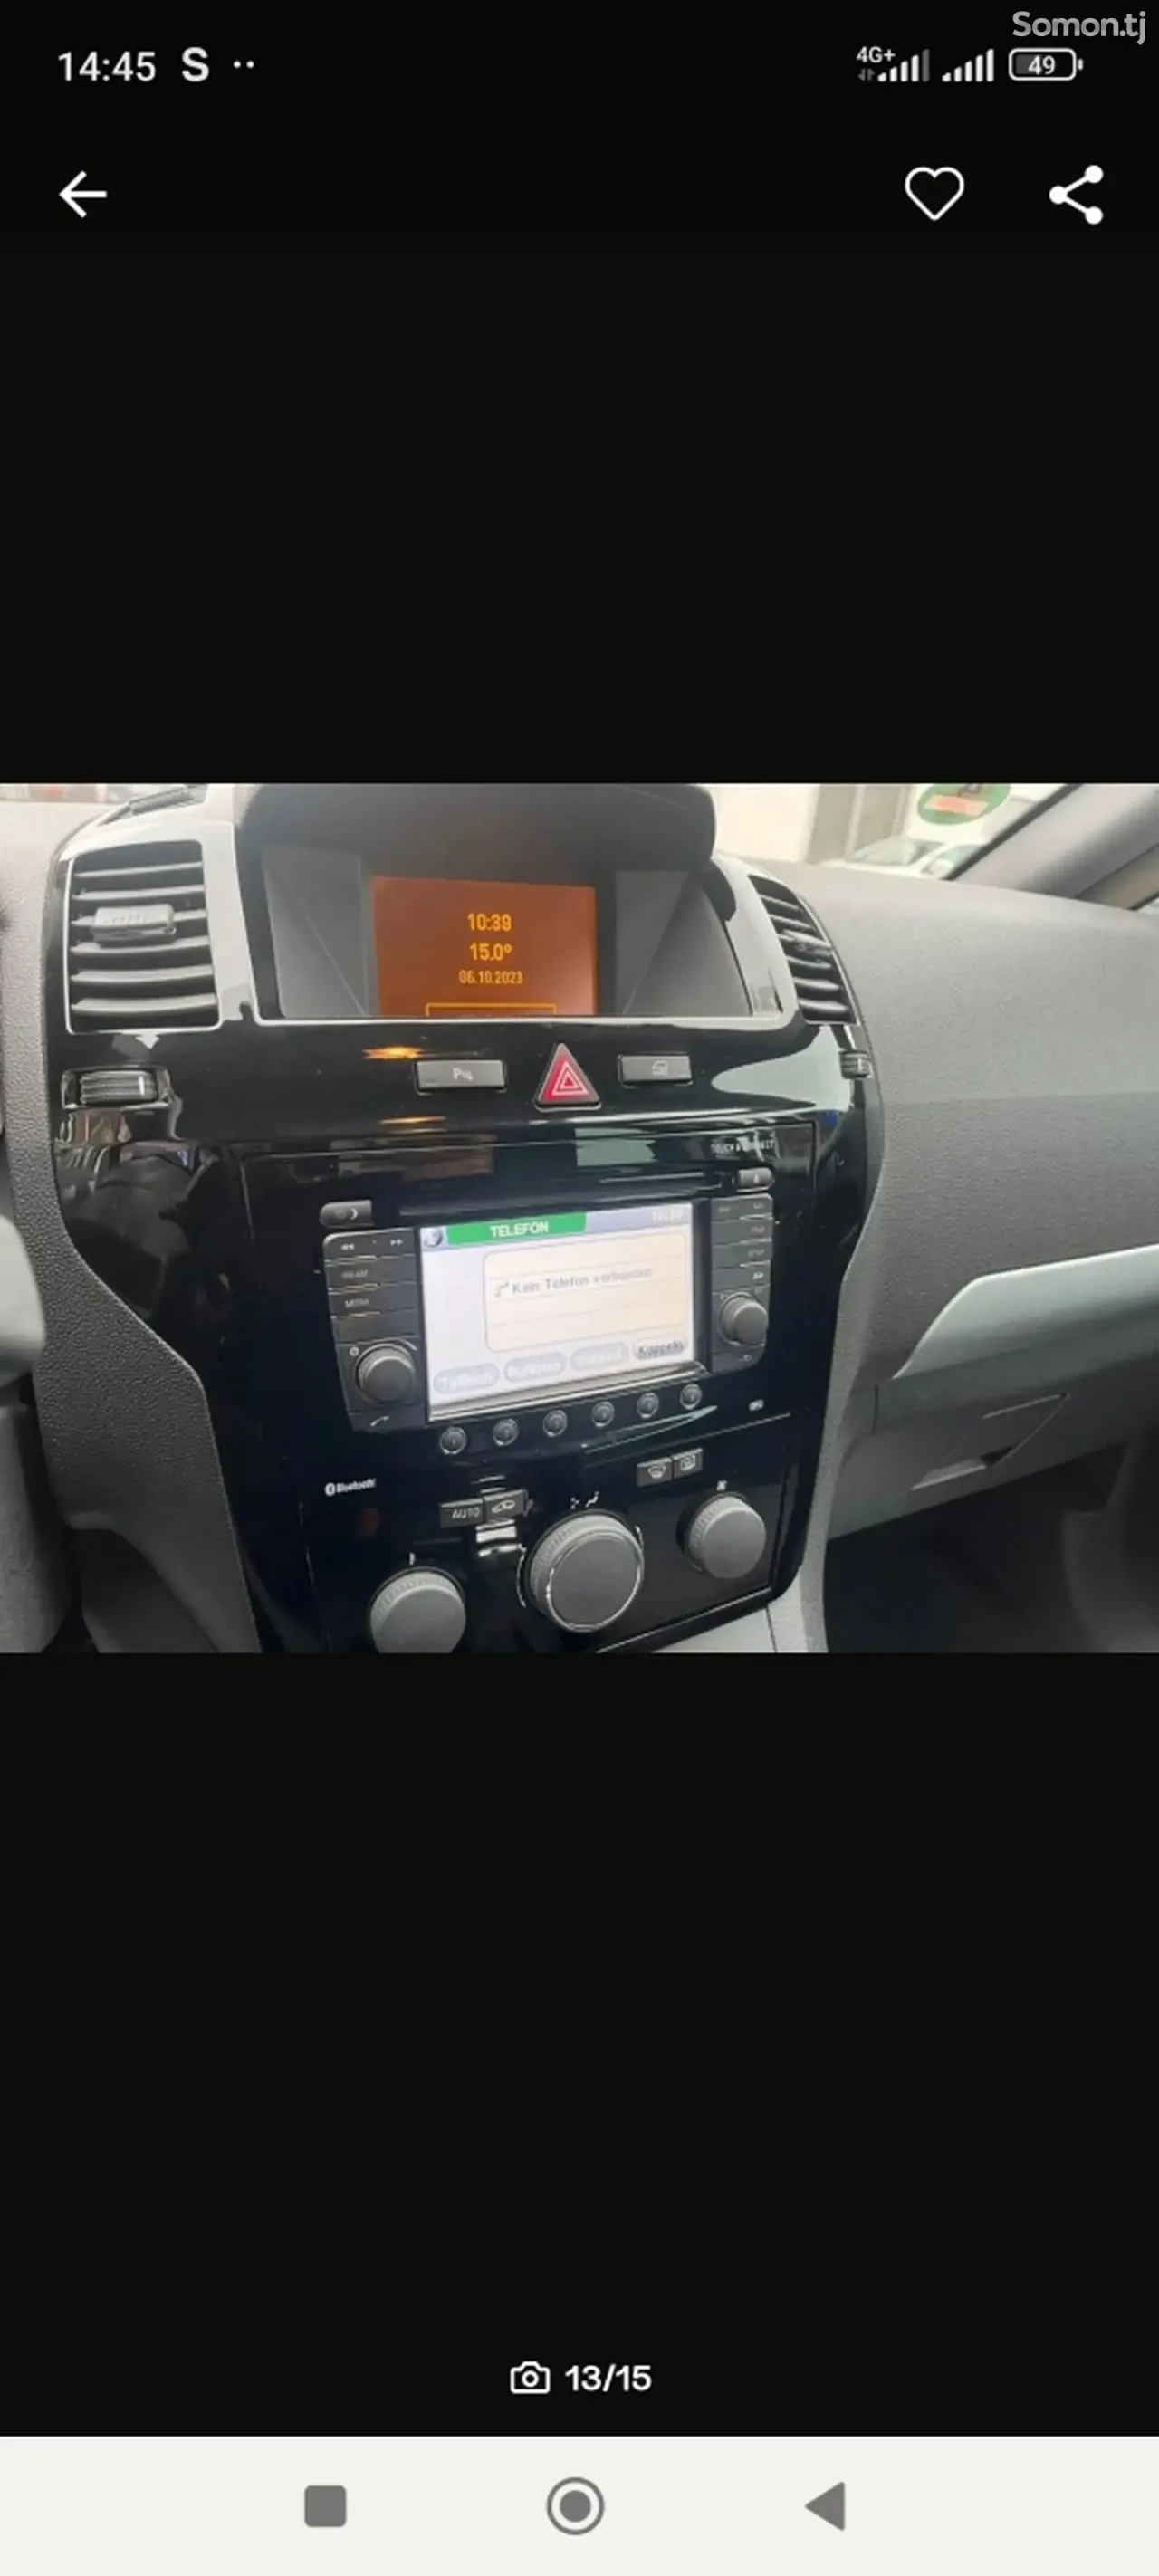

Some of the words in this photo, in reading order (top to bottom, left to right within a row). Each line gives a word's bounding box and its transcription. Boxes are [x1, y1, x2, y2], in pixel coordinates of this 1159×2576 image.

[856, 46, 896, 63] 4G+
[57, 51, 157, 82] 14:45
[1028, 55, 1056, 75] 49
[466, 913, 512, 932] 10:39
[458, 969, 524, 984] 06.10.2023
[489, 1220, 550, 1238] TELEFON
[512, 1281, 541, 1295] Kein
[544, 1275, 589, 1290] Telefon
[452, 1506, 481, 1519] AUTO
[564, 2362, 652, 2392] 13/15
